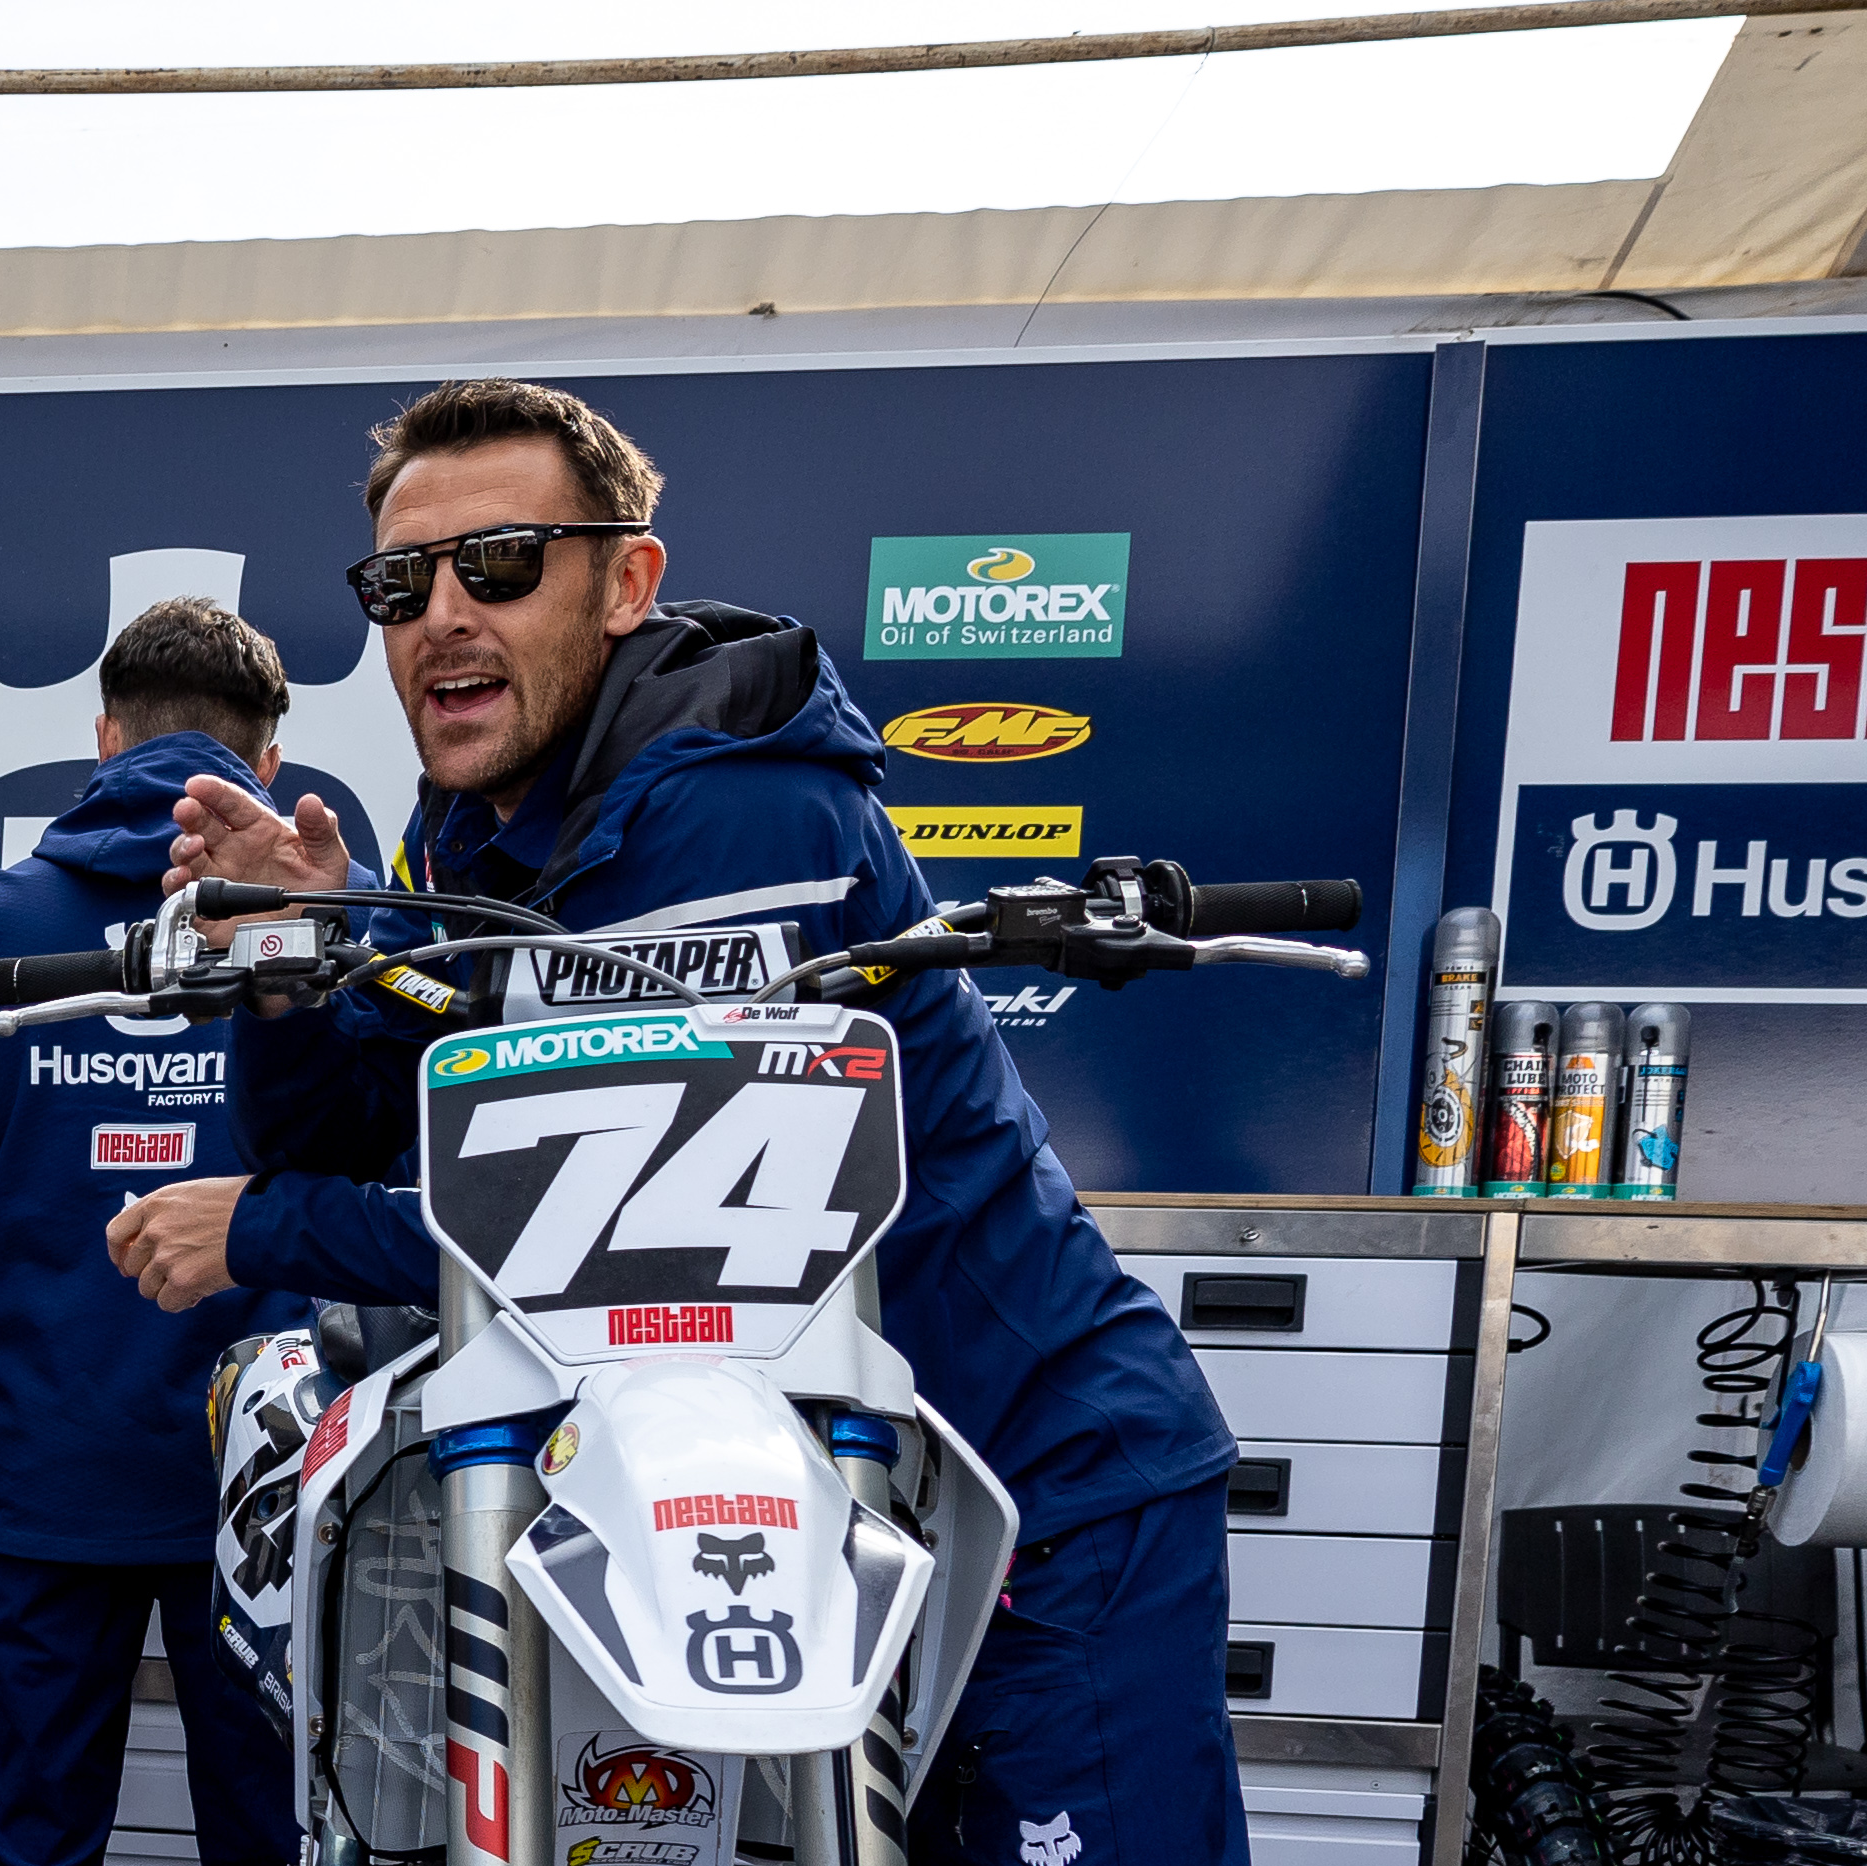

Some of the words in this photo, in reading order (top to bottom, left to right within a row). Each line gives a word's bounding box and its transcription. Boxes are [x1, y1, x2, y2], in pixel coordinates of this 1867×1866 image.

[882, 583, 1112, 624] MOTOREX
[880, 626, 914, 646] Oil
[925, 625, 951, 646] of
[961, 624, 1113, 646] Switzerland
[883, 710, 1091, 746] FMF
[908, 823, 1072, 841] DUNLOP
[1026, 907, 1058, 917] brembo
[546, 937, 753, 1002] PROTAPER
[740, 1006, 761, 1021] De
[764, 1006, 800, 1021] Wolf
[495, 1022, 700, 1070] MOTOREX
[757, 1043, 887, 1080] MX2
[148, 1093, 213, 1108] FACTORY
[457, 1081, 867, 1300] 74
[607, 1306, 734, 1346] nestaan
[652, 1493, 799, 1533] nestaan
